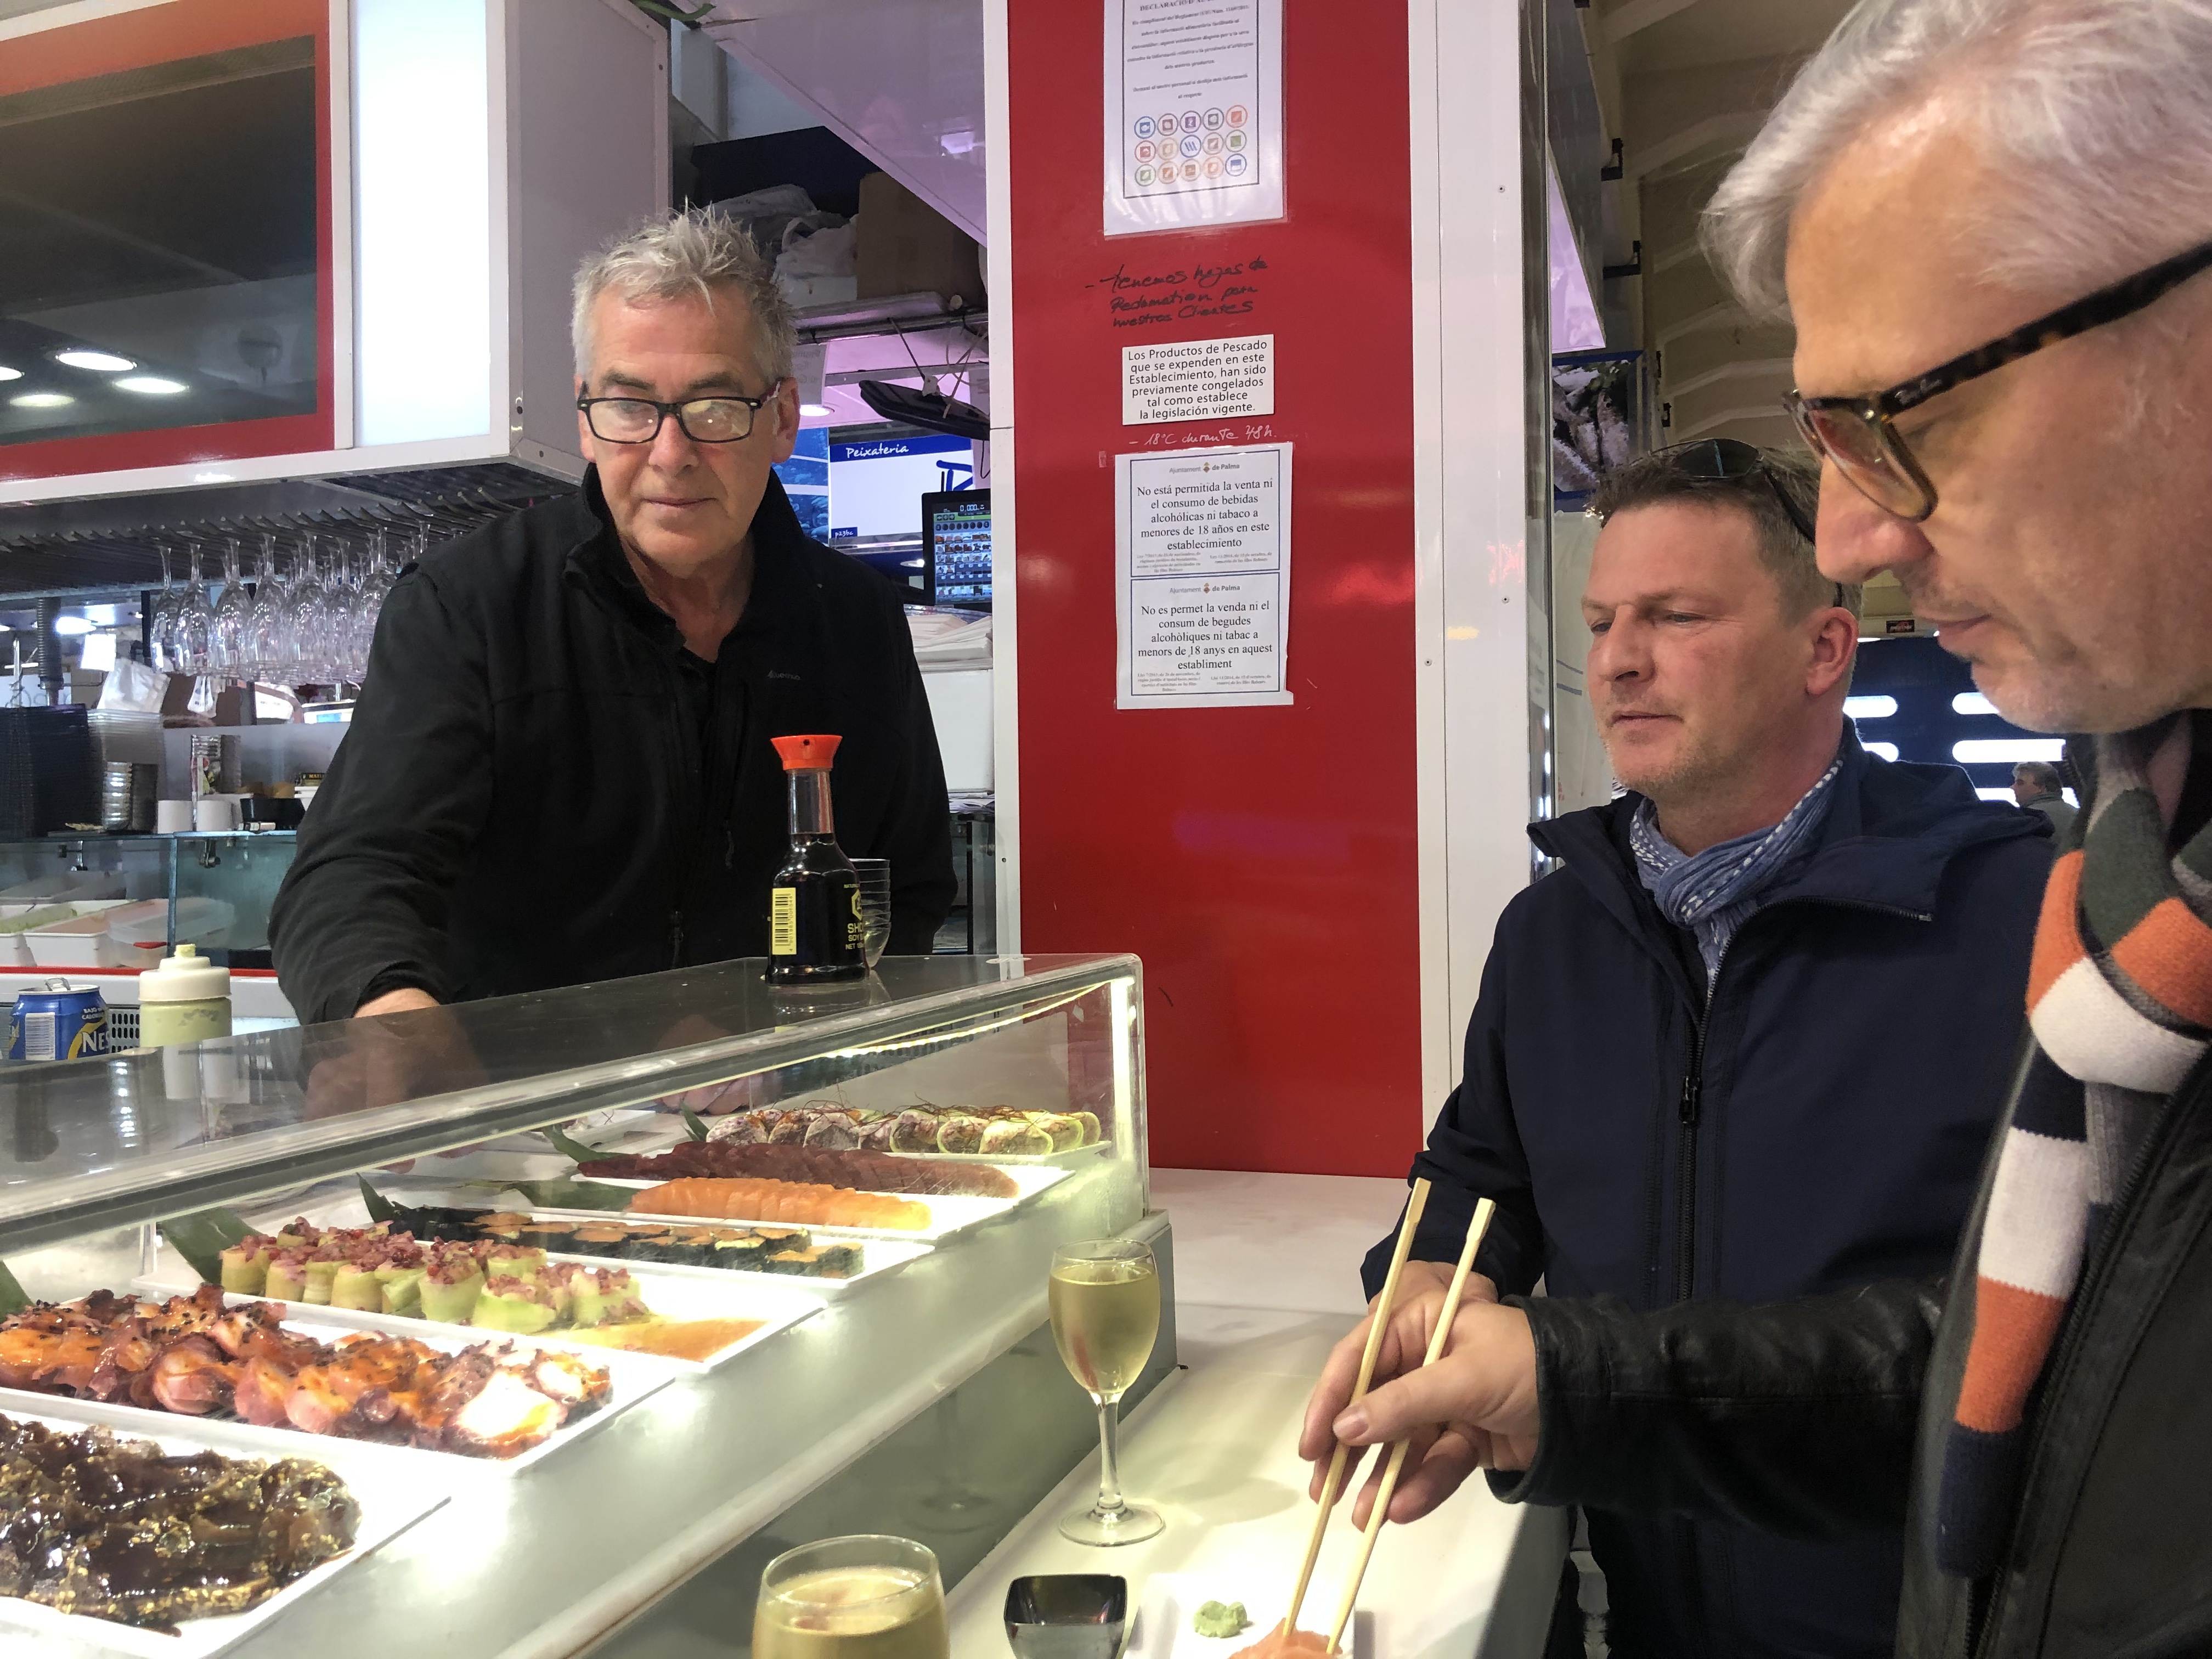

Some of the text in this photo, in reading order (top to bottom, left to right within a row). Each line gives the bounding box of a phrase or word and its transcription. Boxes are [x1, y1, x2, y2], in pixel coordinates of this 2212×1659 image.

[1128, 340, 1267, 360] Los Productos de Pescado
[1131, 353, 1265, 374] que se expenden en este
[1130, 364, 1266, 384] Establecimiento, han sido
[1132, 377, 1264, 398] previamente congelados
[1147, 391, 1248, 407] tal como establece
[1140, 403, 1255, 420] la legislación vigente.
[845, 443, 909, 458] Peixateria
[1137, 478, 1273, 496] No está permitida la venta ni
[1151, 493, 1259, 509] el consumo de bebidas
[1151, 511, 1204, 523] alcohólicas
[1207, 510, 1216, 520] ni
[1219, 509, 1250, 519] tabaco
[1141, 522, 1270, 538] menores de 18 años en este
[1167, 538, 1242, 550] establecimiento
[1142, 606, 1155, 616] No
[1171, 605, 1203, 616] permet
[1206, 603, 1215, 612] la
[1218, 602, 1246, 612] venda
[1249, 601, 1259, 611] ni
[1261, 601, 1269, 610] el
[1159, 617, 1251, 628] consum de begudes
[1151, 631, 1211, 645] alcohòliques
[1213, 630, 1222, 640] ni
[1226, 630, 1250, 640] tabac
[1138, 648, 1172, 657] menors
[1175, 647, 1187, 656] de
[1190, 646, 1200, 655] 18
[1203, 645, 1225, 657] anys
[1242, 644, 1273, 655] aquest
[1177, 659, 1232, 670] establiment
